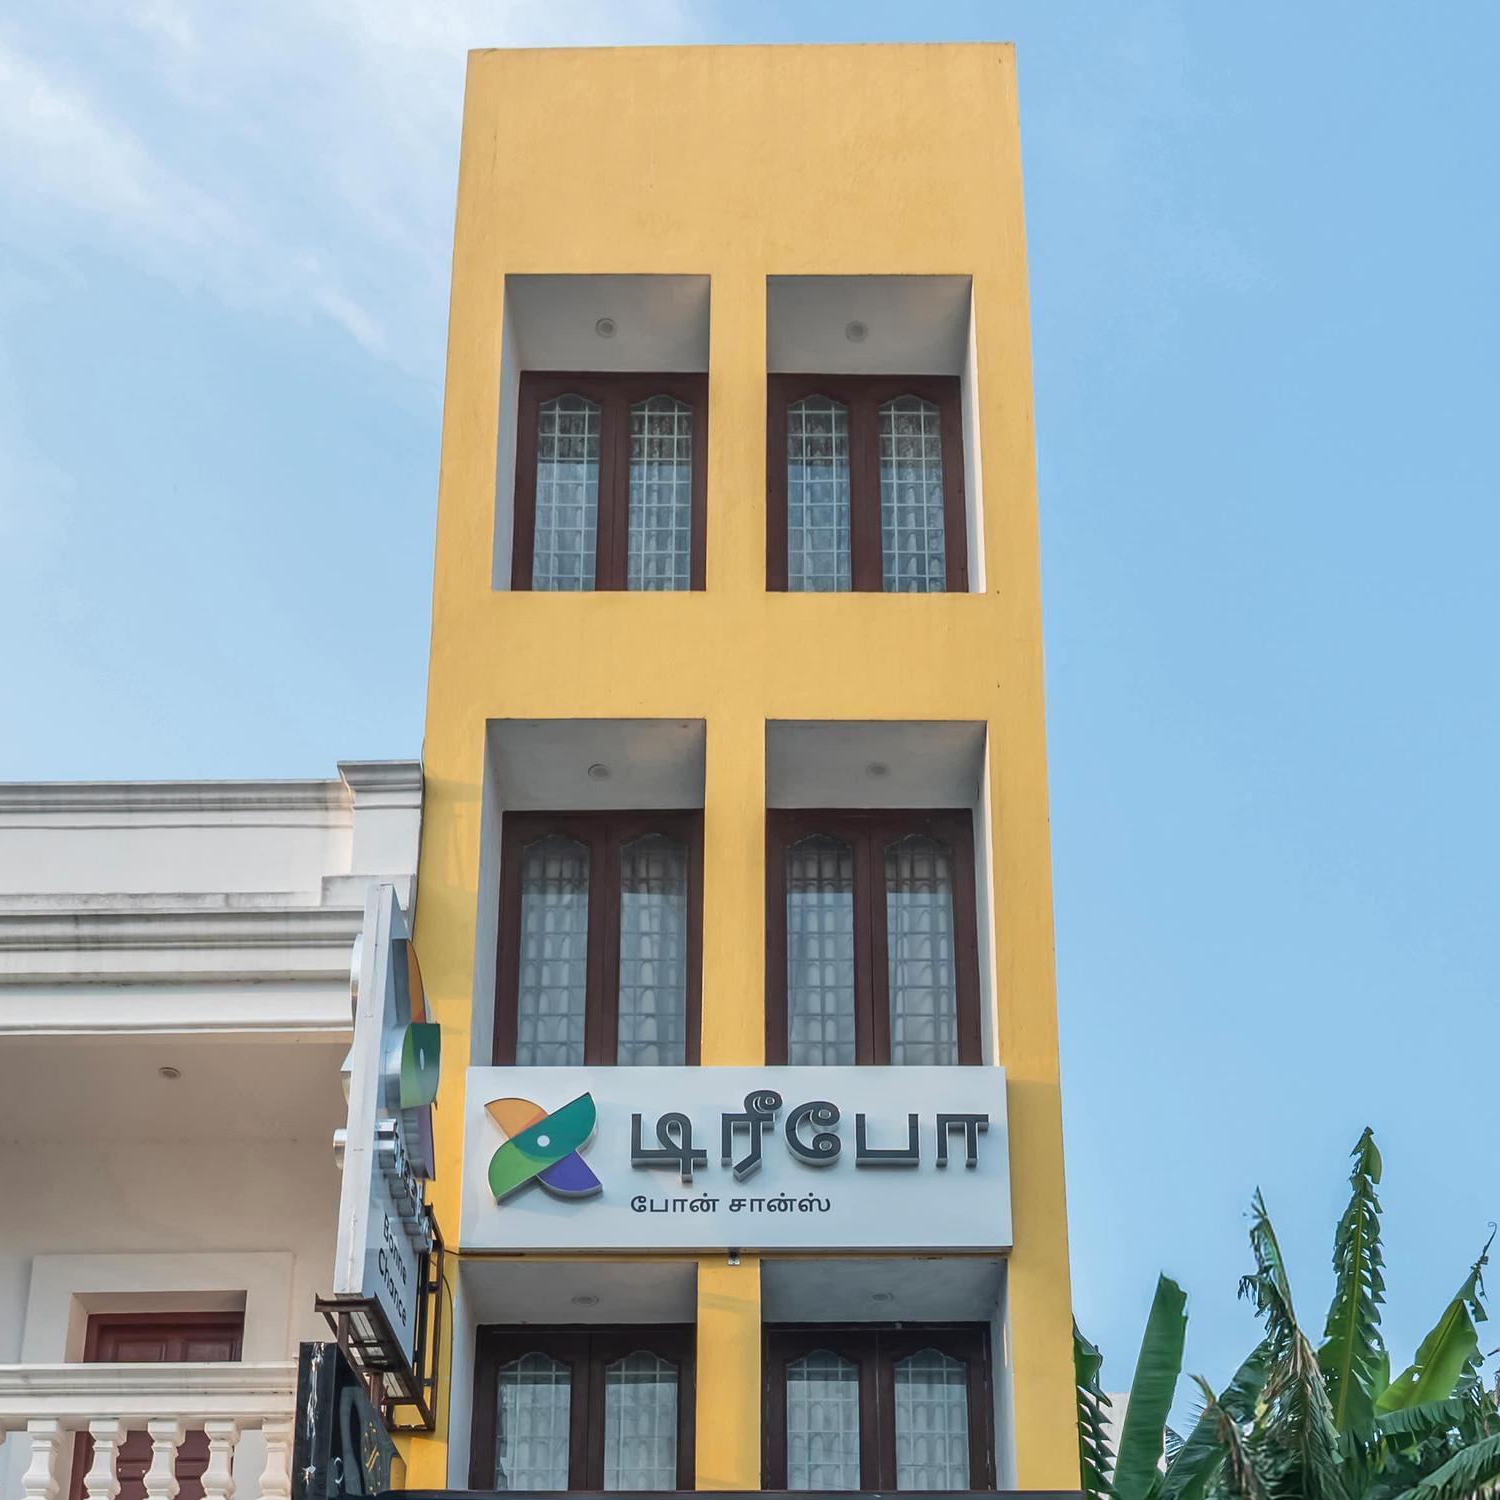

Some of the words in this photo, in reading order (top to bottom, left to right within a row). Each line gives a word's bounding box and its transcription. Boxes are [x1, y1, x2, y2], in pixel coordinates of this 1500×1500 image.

[630, 1089, 990, 1183] டிரீபோ
[630, 1192, 720, 1213] போன்
[377, 1247, 407, 1328] Chance
[383, 1211, 407, 1286] Bonne
